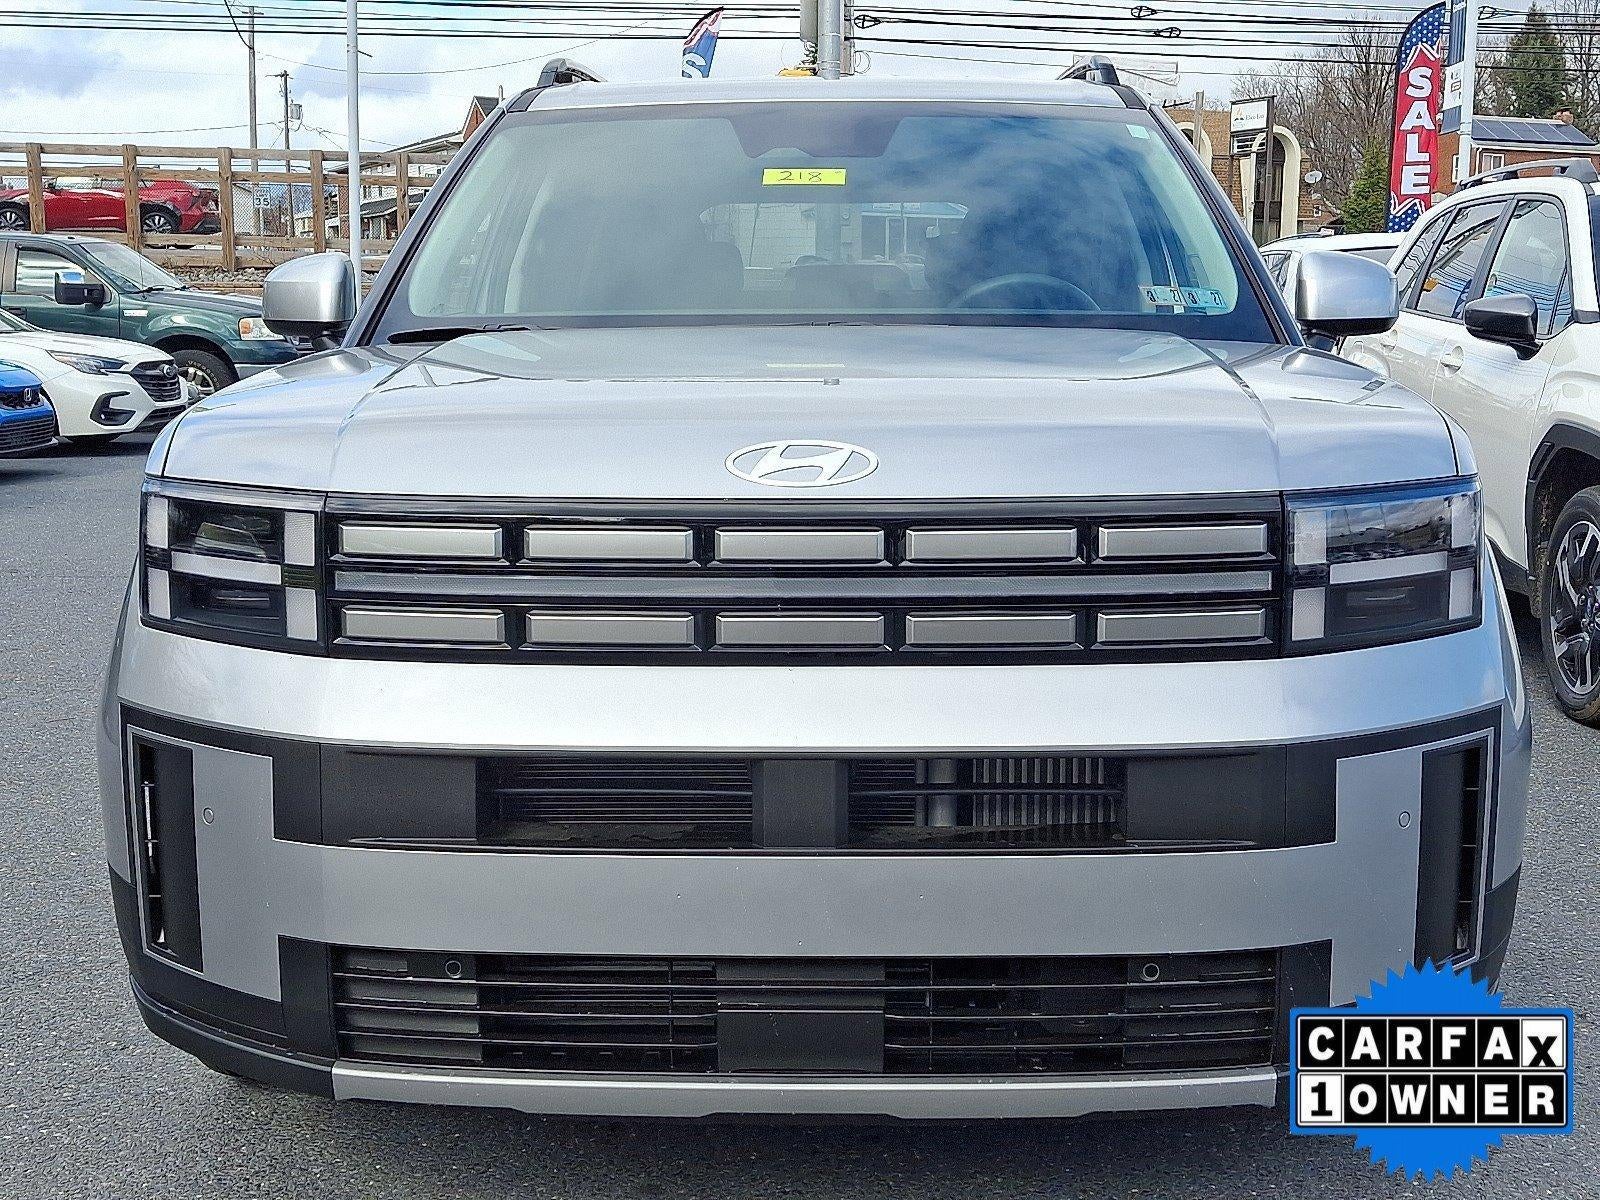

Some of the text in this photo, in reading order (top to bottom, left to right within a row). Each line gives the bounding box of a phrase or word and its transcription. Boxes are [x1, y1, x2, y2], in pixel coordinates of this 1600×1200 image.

[1400, 66, 1436, 195] SALE
[777, 170, 823, 183] 218
[255, 197, 270, 207] 35
